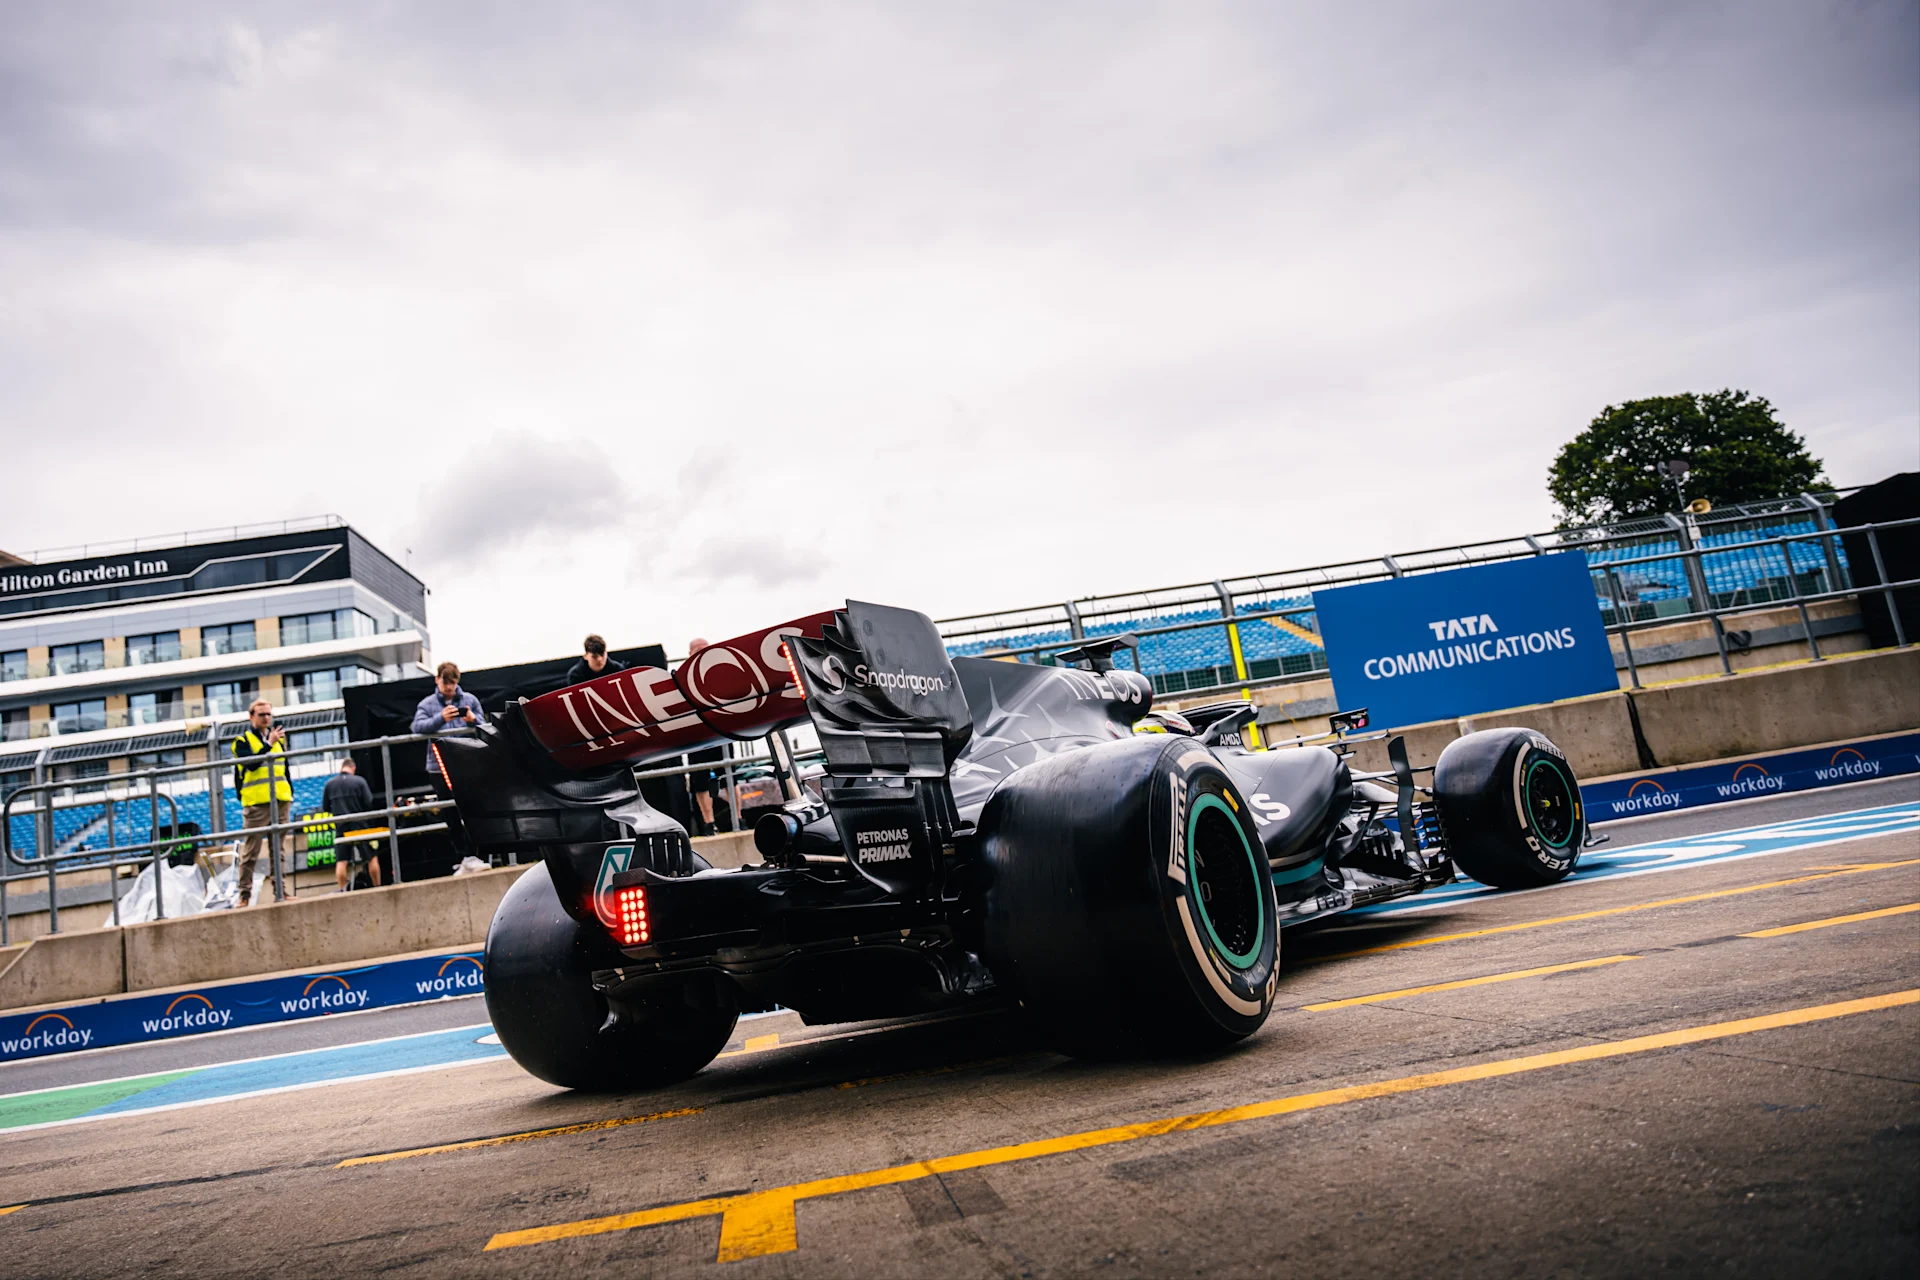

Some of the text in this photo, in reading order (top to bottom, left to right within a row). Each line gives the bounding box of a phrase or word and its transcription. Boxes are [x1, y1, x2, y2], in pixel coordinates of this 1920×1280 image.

[0, 560, 169, 592] Hilton Garden Inn
[1428, 614, 1499, 641] TATA
[1364, 627, 1575, 680] COMMUNICATIONS
[558, 627, 803, 751] INEOS
[854, 664, 944, 696] Snapdragon
[1057, 670, 1142, 704] INEOS
[1220, 732, 1236, 746] AMD
[1529, 736, 1565, 760] PIRELLI
[1814, 760, 1880, 781] workday
[1716, 776, 1783, 797] workday
[1611, 792, 1680, 813] workday
[856, 828, 909, 845] PETRONAS
[1167, 771, 1188, 886] PIRELLI
[858, 841, 912, 864] PRIMAX
[415, 968, 484, 994] workd
[280, 988, 368, 1014] workday
[142, 1007, 231, 1033] workday
[1, 1027, 92, 1054] workday
